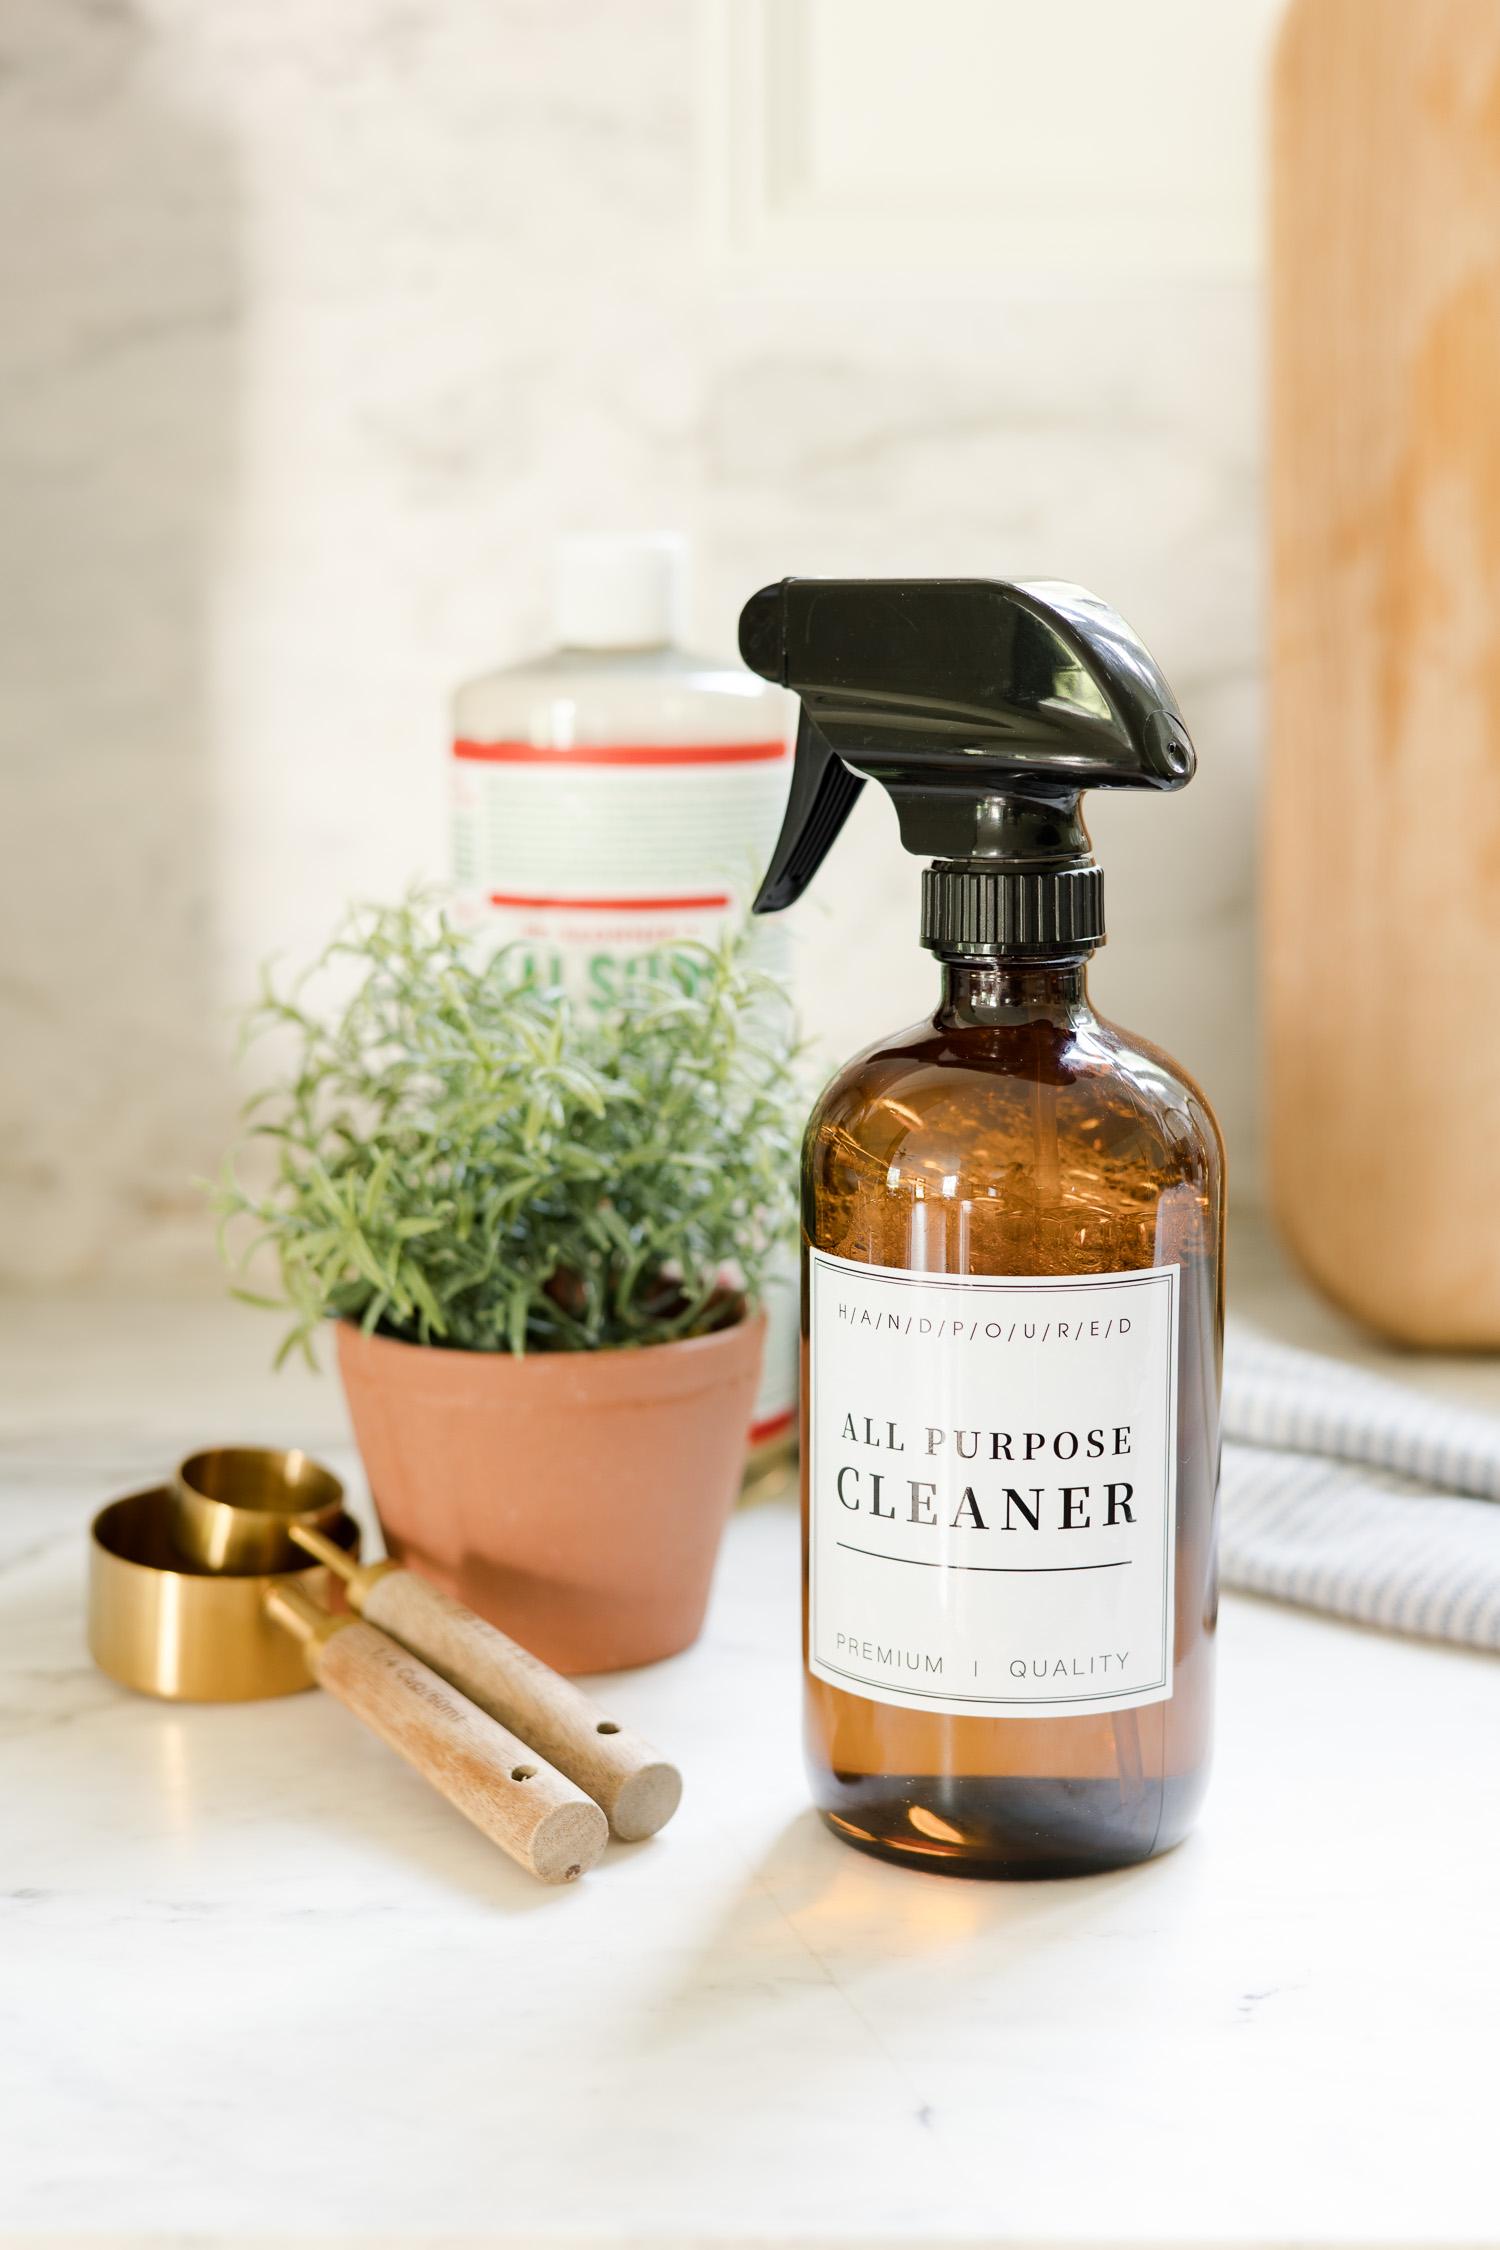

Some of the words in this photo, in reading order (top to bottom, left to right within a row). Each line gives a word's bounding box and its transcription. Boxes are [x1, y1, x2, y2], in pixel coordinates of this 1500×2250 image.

[838, 1303, 1132, 1342] H/A/N/D/P/O/U/R/E/D
[841, 1412, 905, 1452] ALL
[924, 1425, 1132, 1461] PURPOSE
[836, 1466, 1138, 1531] CLEANER
[836, 1632, 943, 1675] PREMIUM
[1009, 1651, 1130, 1679] QUALITY
